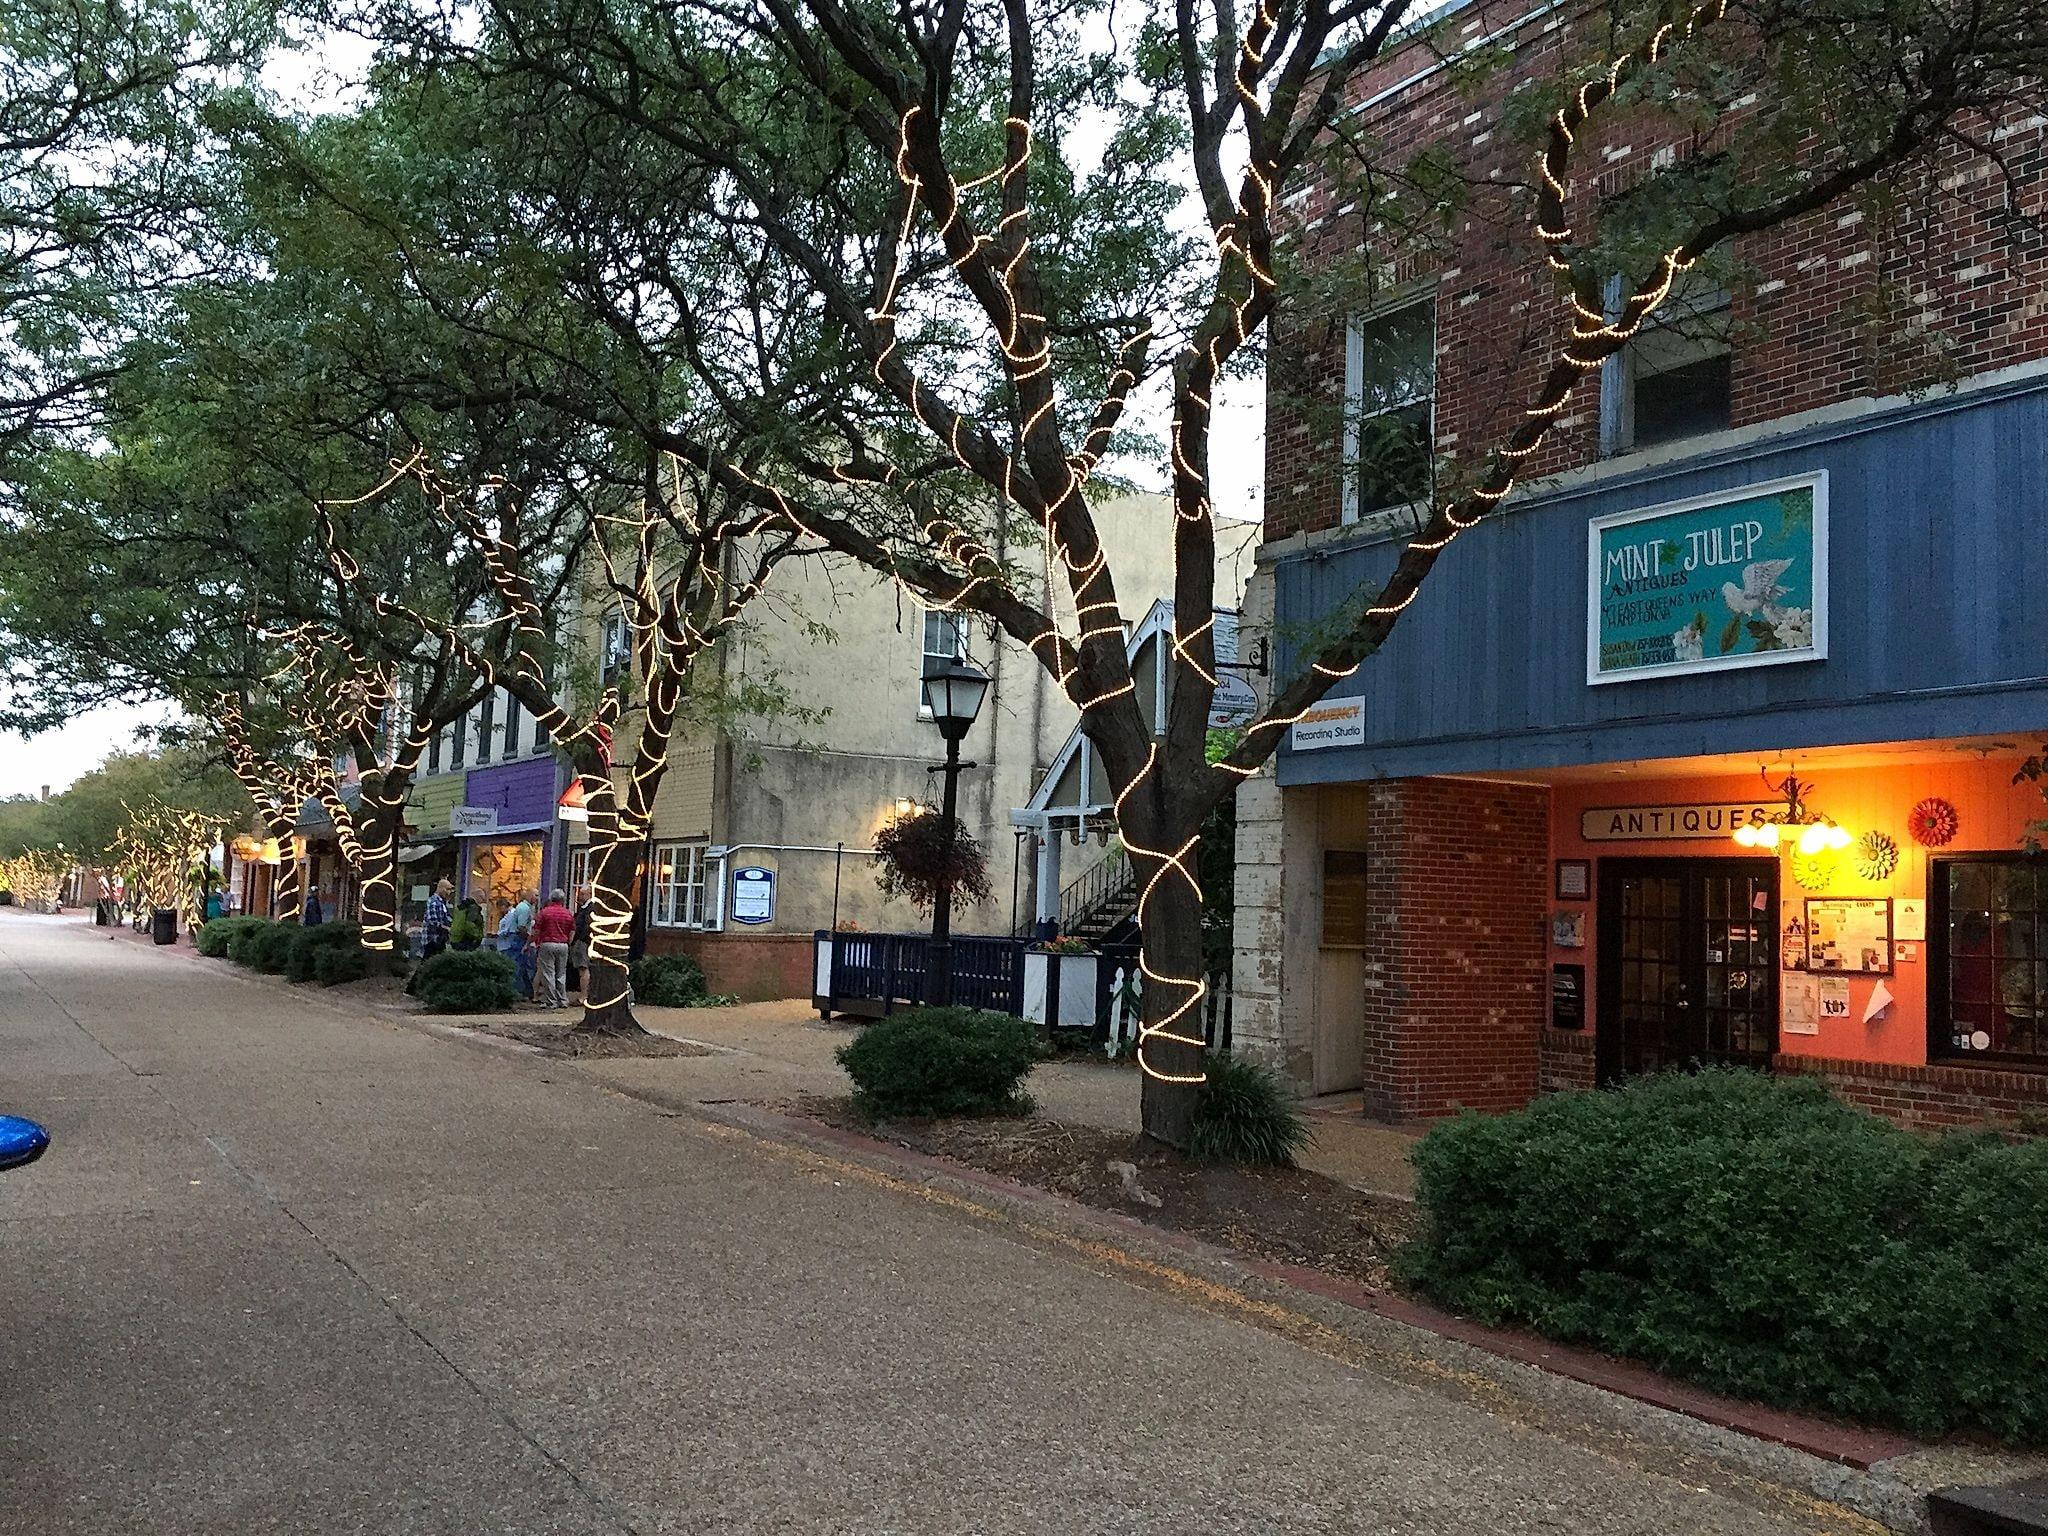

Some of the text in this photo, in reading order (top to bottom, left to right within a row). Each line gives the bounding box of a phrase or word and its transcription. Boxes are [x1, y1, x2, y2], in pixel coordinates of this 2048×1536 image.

[1605, 521, 1762, 585] MINT JULEP
[1607, 570, 1688, 600] ANTIQUES
[1646, 593, 1684, 611] QUEENS
[1689, 588, 1716, 604] WAY
[1296, 726, 1361, 741] Recording Studio
[1609, 808, 1766, 833] ANTIQUES
